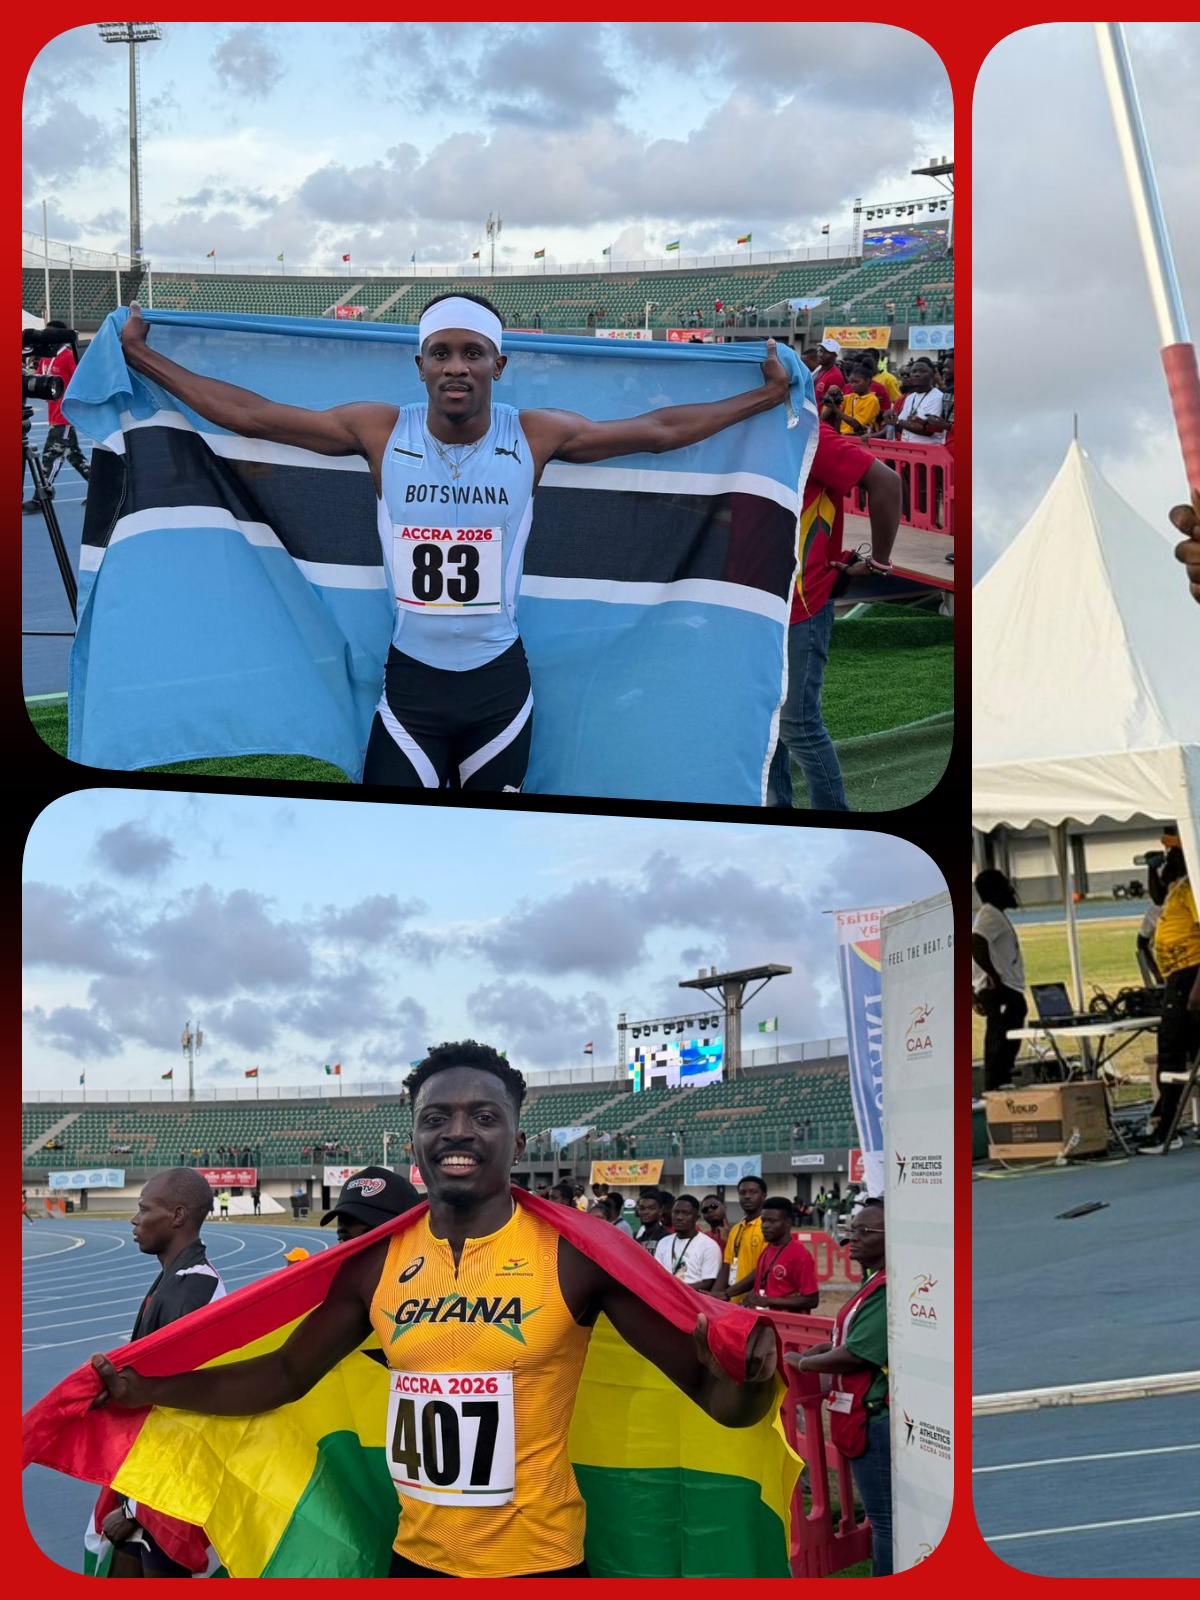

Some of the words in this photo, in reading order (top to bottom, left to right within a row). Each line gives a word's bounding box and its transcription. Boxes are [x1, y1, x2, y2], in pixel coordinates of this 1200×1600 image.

[405, 484, 509, 505] BOTSWANA
[401, 527, 453, 541] ACCRA
[456, 528, 493, 541] 2026
[412, 543, 480, 602] 83
[888, 950, 904, 966] FEEL
[907, 945, 920, 959] THE
[923, 938, 944, 955] HEAT.
[906, 1035, 933, 1052] CAA
[911, 1162, 942, 1170] ATHLETICS
[394, 1296, 522, 1325] GHANA
[910, 1303, 937, 1320] CAA
[395, 1375, 443, 1395] ACCRA
[448, 1377, 499, 1394] 2026
[391, 1398, 499, 1487] 407
[919, 1427, 951, 1445] ATHLETICS
[920, 1443, 937, 1454] ACCRA
